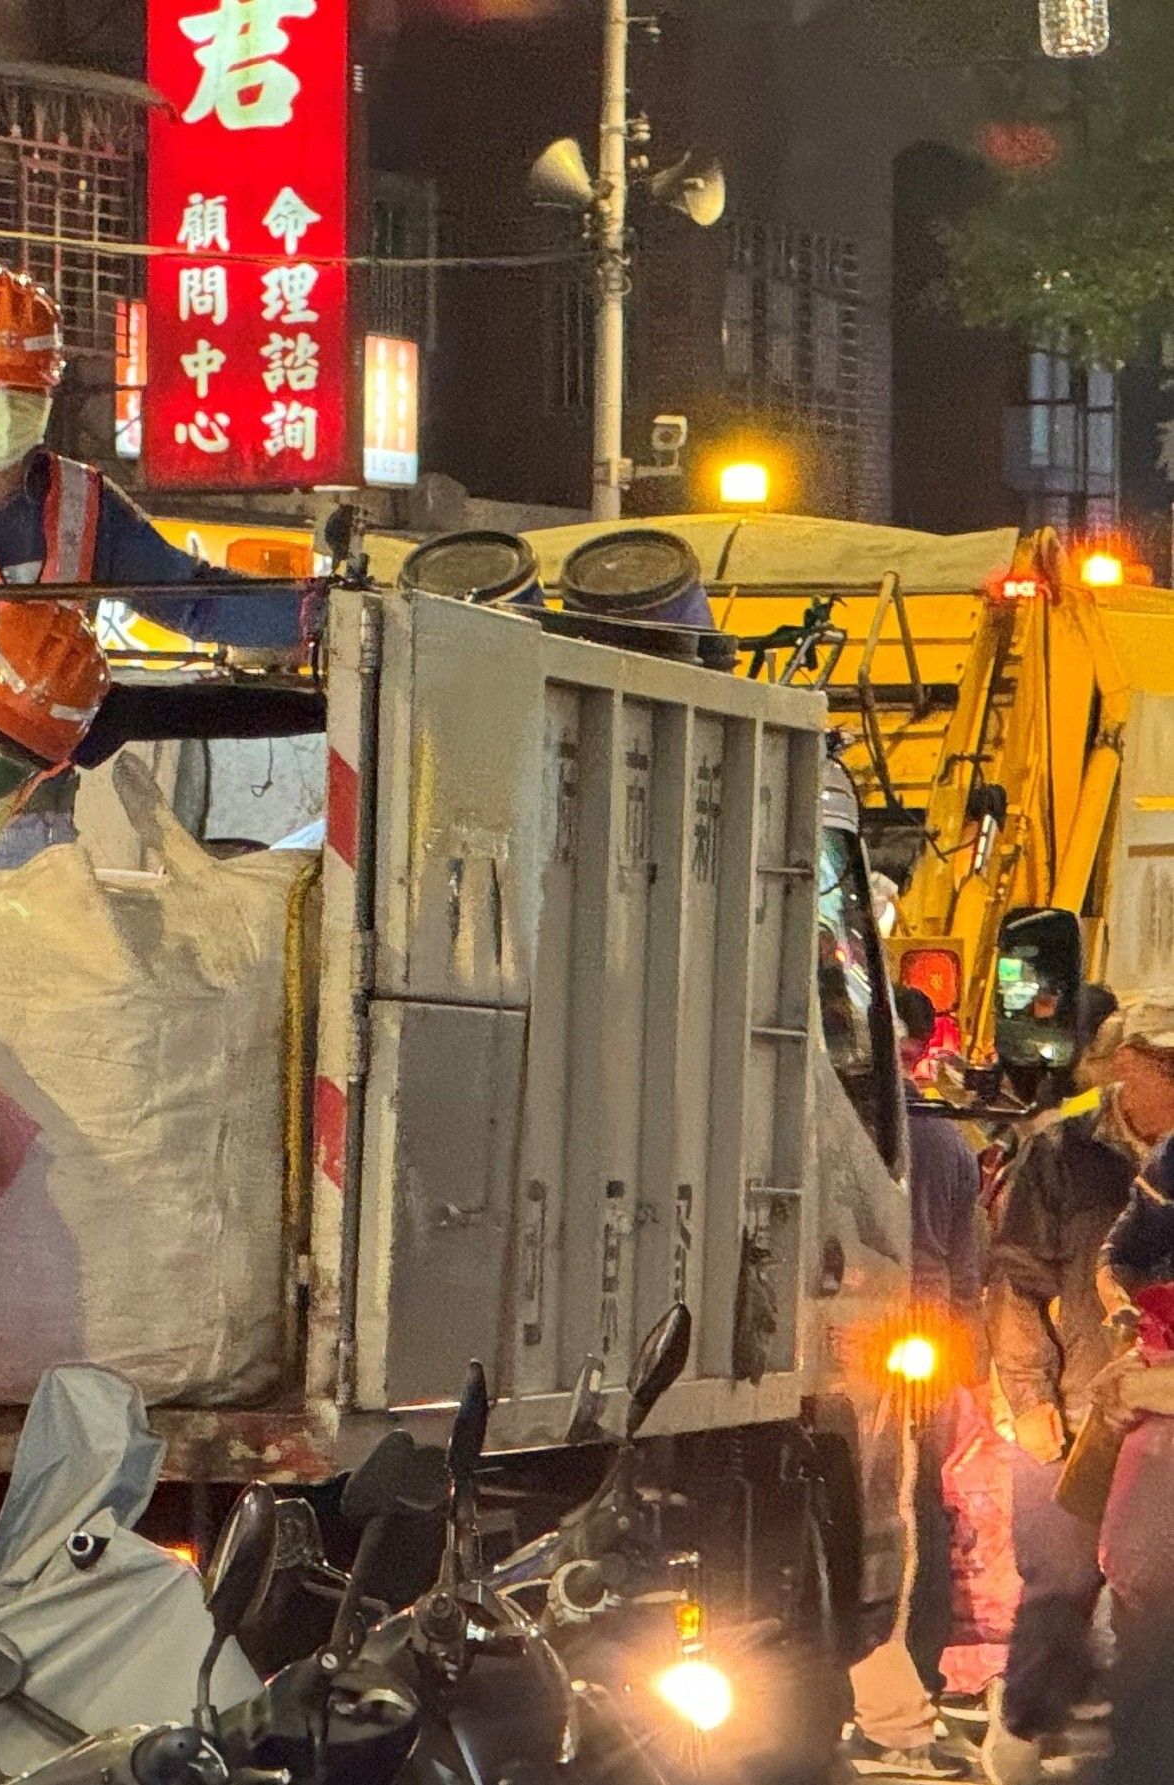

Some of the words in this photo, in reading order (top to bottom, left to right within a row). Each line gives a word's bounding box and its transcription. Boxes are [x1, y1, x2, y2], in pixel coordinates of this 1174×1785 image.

[175, 192, 231, 455] 顧問中心
[261, 186, 322, 462] 命理諮詢
